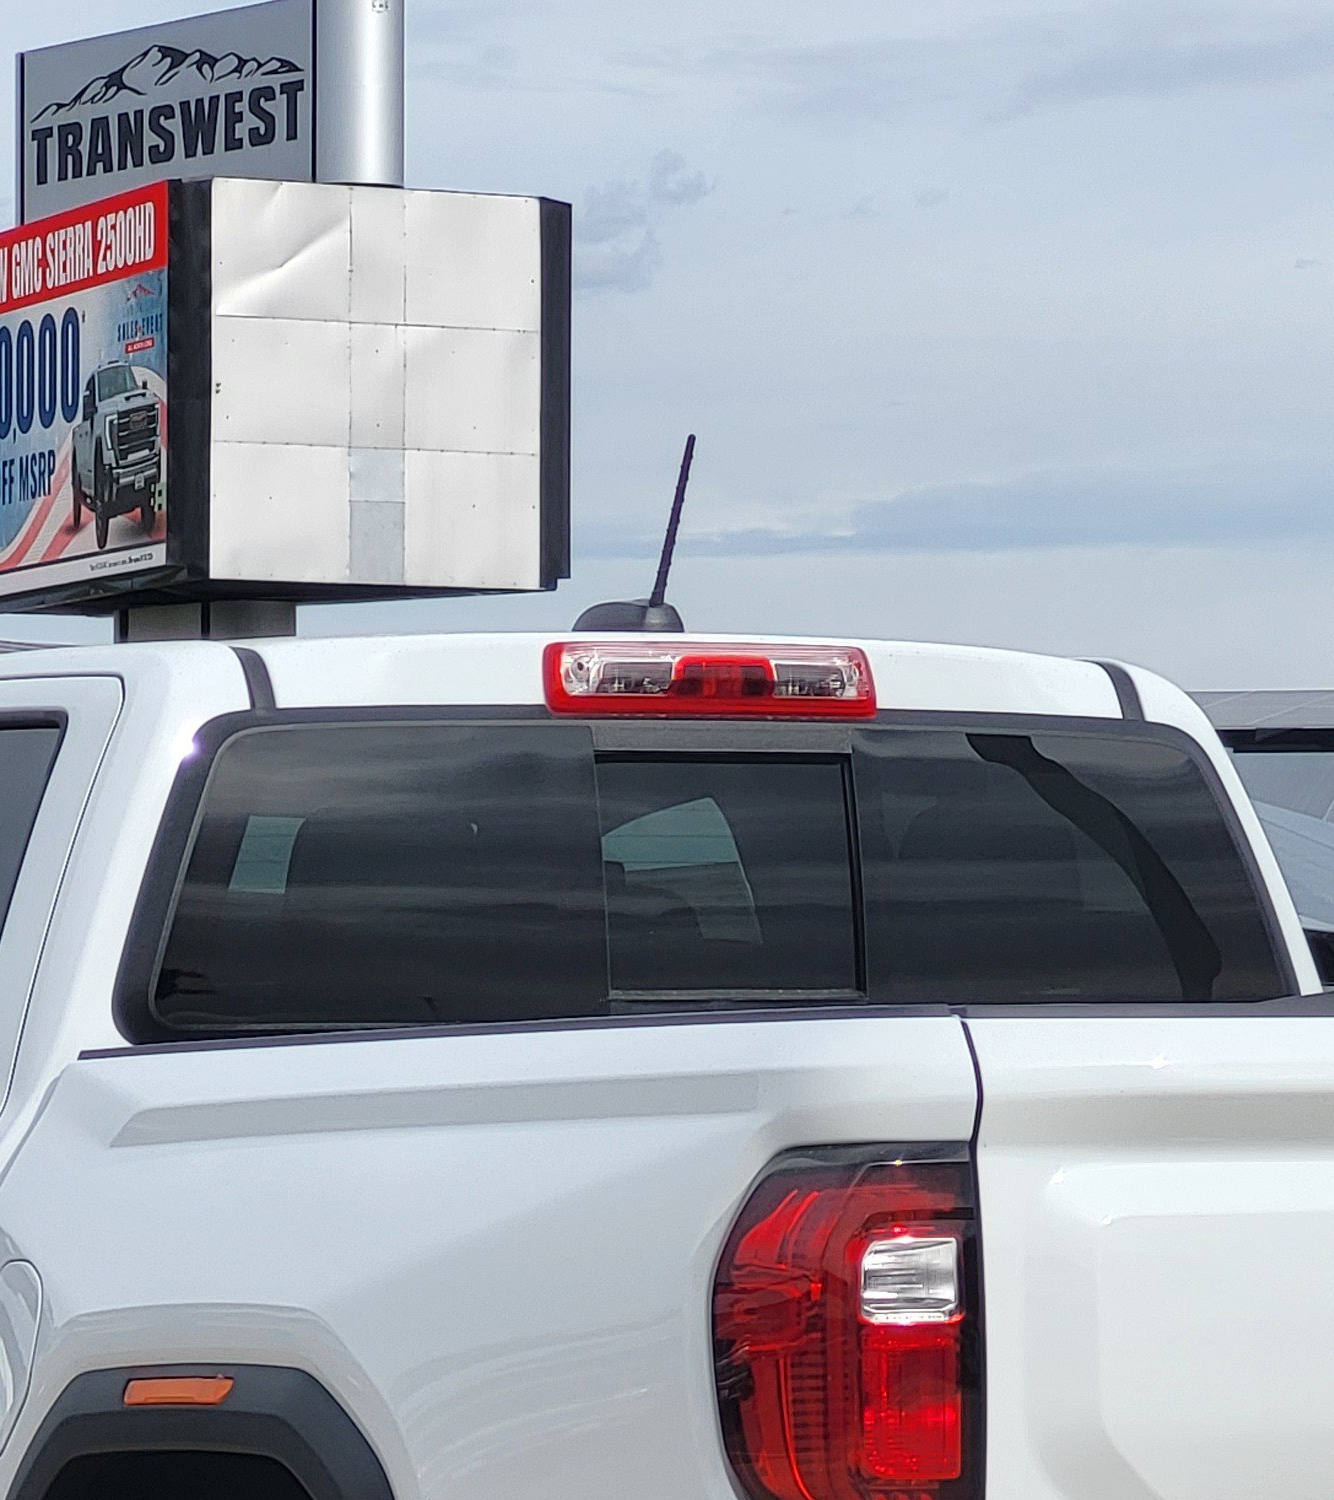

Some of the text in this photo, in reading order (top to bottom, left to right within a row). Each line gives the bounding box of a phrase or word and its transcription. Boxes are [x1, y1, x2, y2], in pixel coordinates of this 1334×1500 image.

[31, 79, 305, 186] TRANSWEST
[11, 236, 43, 300] GMC
[45, 220, 94, 290] SIERRA
[96, 201, 155, 275] 2500HD
[19, 449, 56, 502] MSRP
